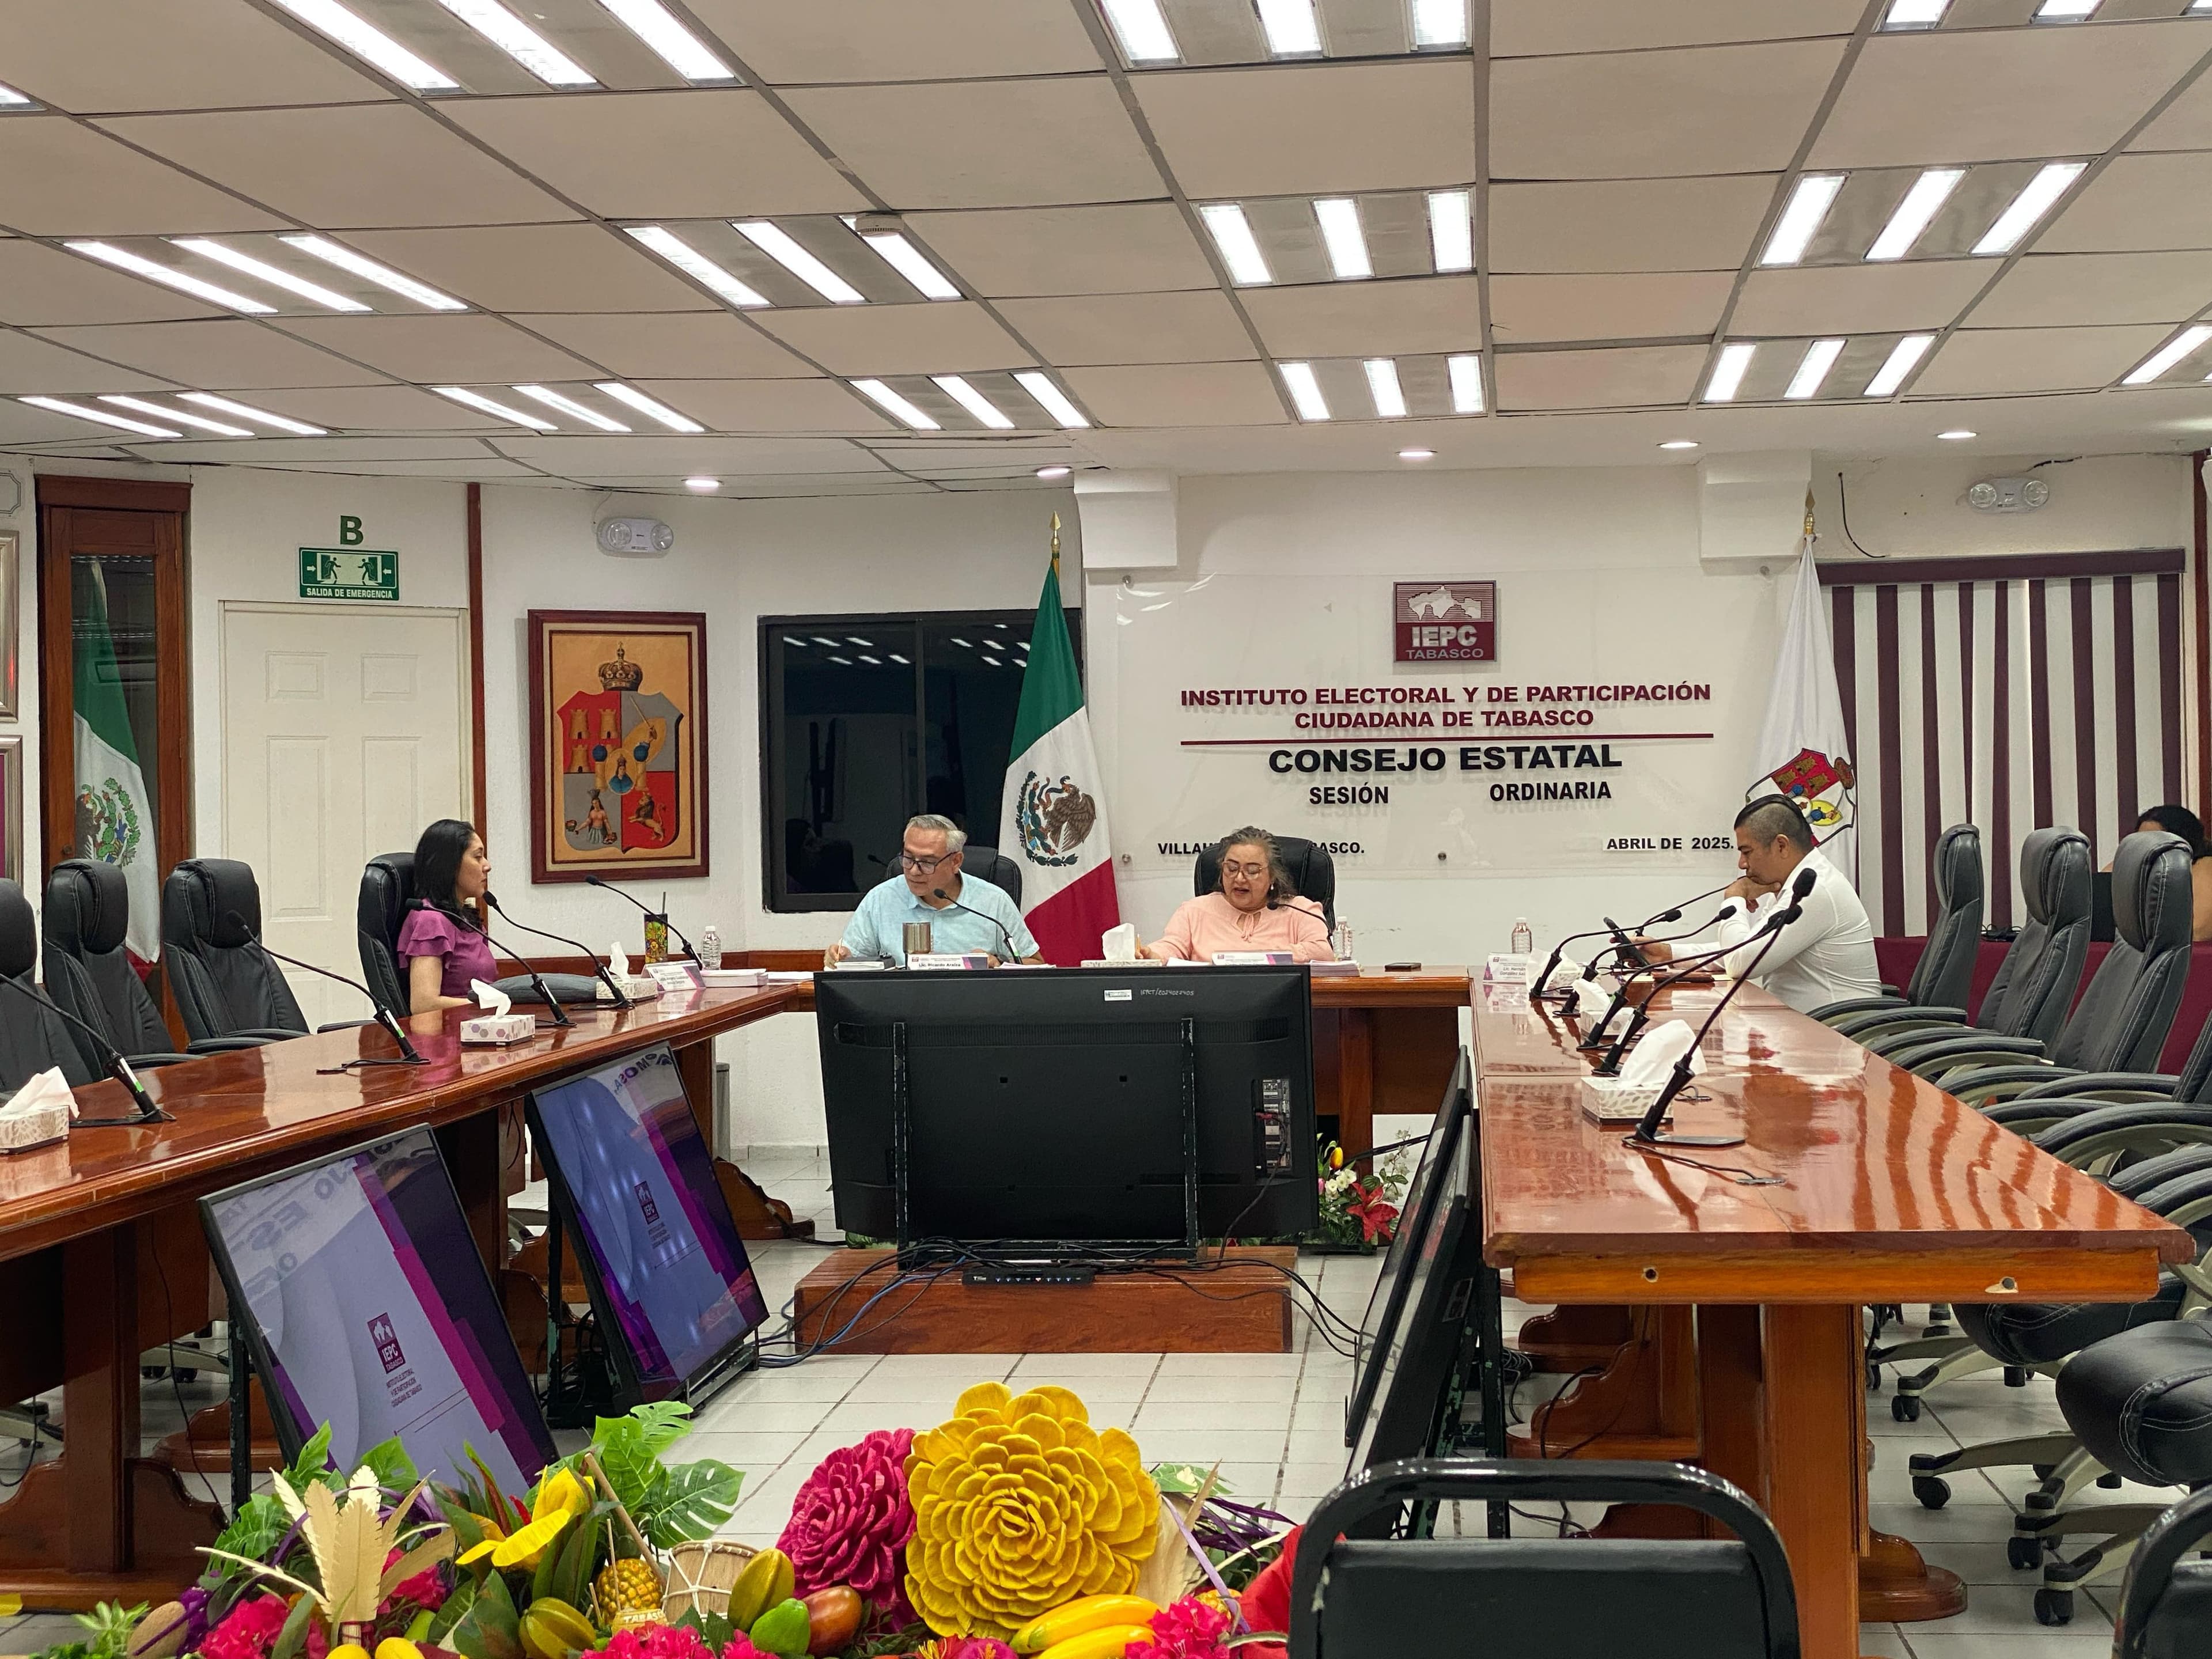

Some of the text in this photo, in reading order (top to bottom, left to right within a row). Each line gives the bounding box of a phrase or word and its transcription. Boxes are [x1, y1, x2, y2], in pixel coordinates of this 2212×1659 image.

[340, 515, 363, 545] B
[306, 588, 393, 599] SALIDA DE EMERGENCIA
[1412, 624, 1478, 647] IEPC
[1406, 649, 1484, 659] TABASCO
[1181, 681, 1711, 706] INSTITUTO ELECTORAL Y DE PARTICIPACIÓN
[1295, 709, 1594, 729] CIUDADANA DE TABASCO
[1269, 744, 1622, 773] CONSEJO ESTATAL
[1309, 782, 1389, 804] SESIÓN
[1489, 781, 1612, 801] ORDINARIA
[1607, 837, 1734, 849] ABRIL DE 2025.
[381, 1343, 399, 1362] IEPC
